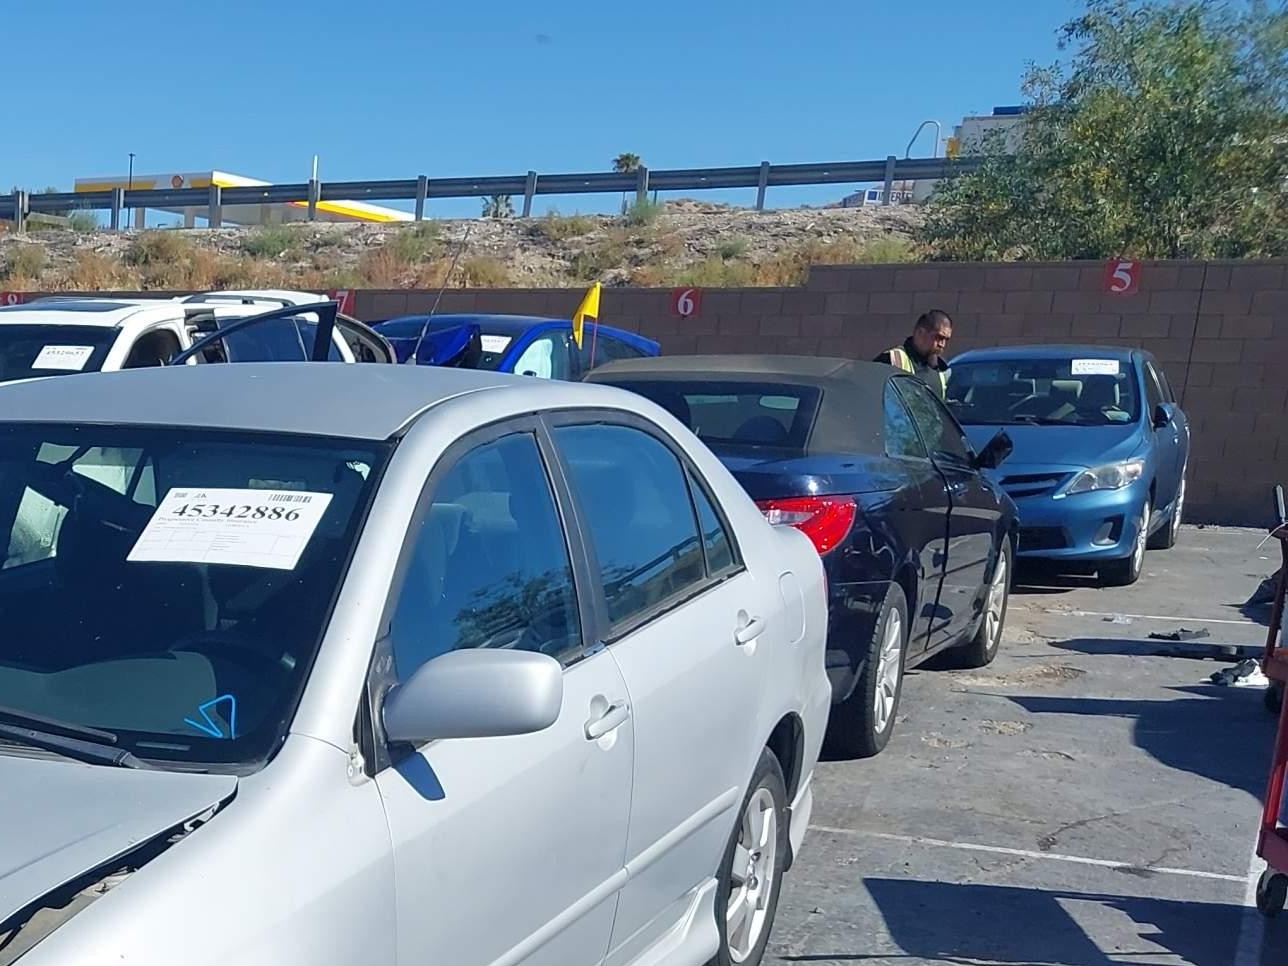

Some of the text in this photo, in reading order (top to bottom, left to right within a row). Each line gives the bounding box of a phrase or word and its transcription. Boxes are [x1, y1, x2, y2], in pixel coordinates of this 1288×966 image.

[1110, 262, 1133, 292] 5
[678, 288, 694, 315] 6
[172, 503, 305, 522] 45342886
